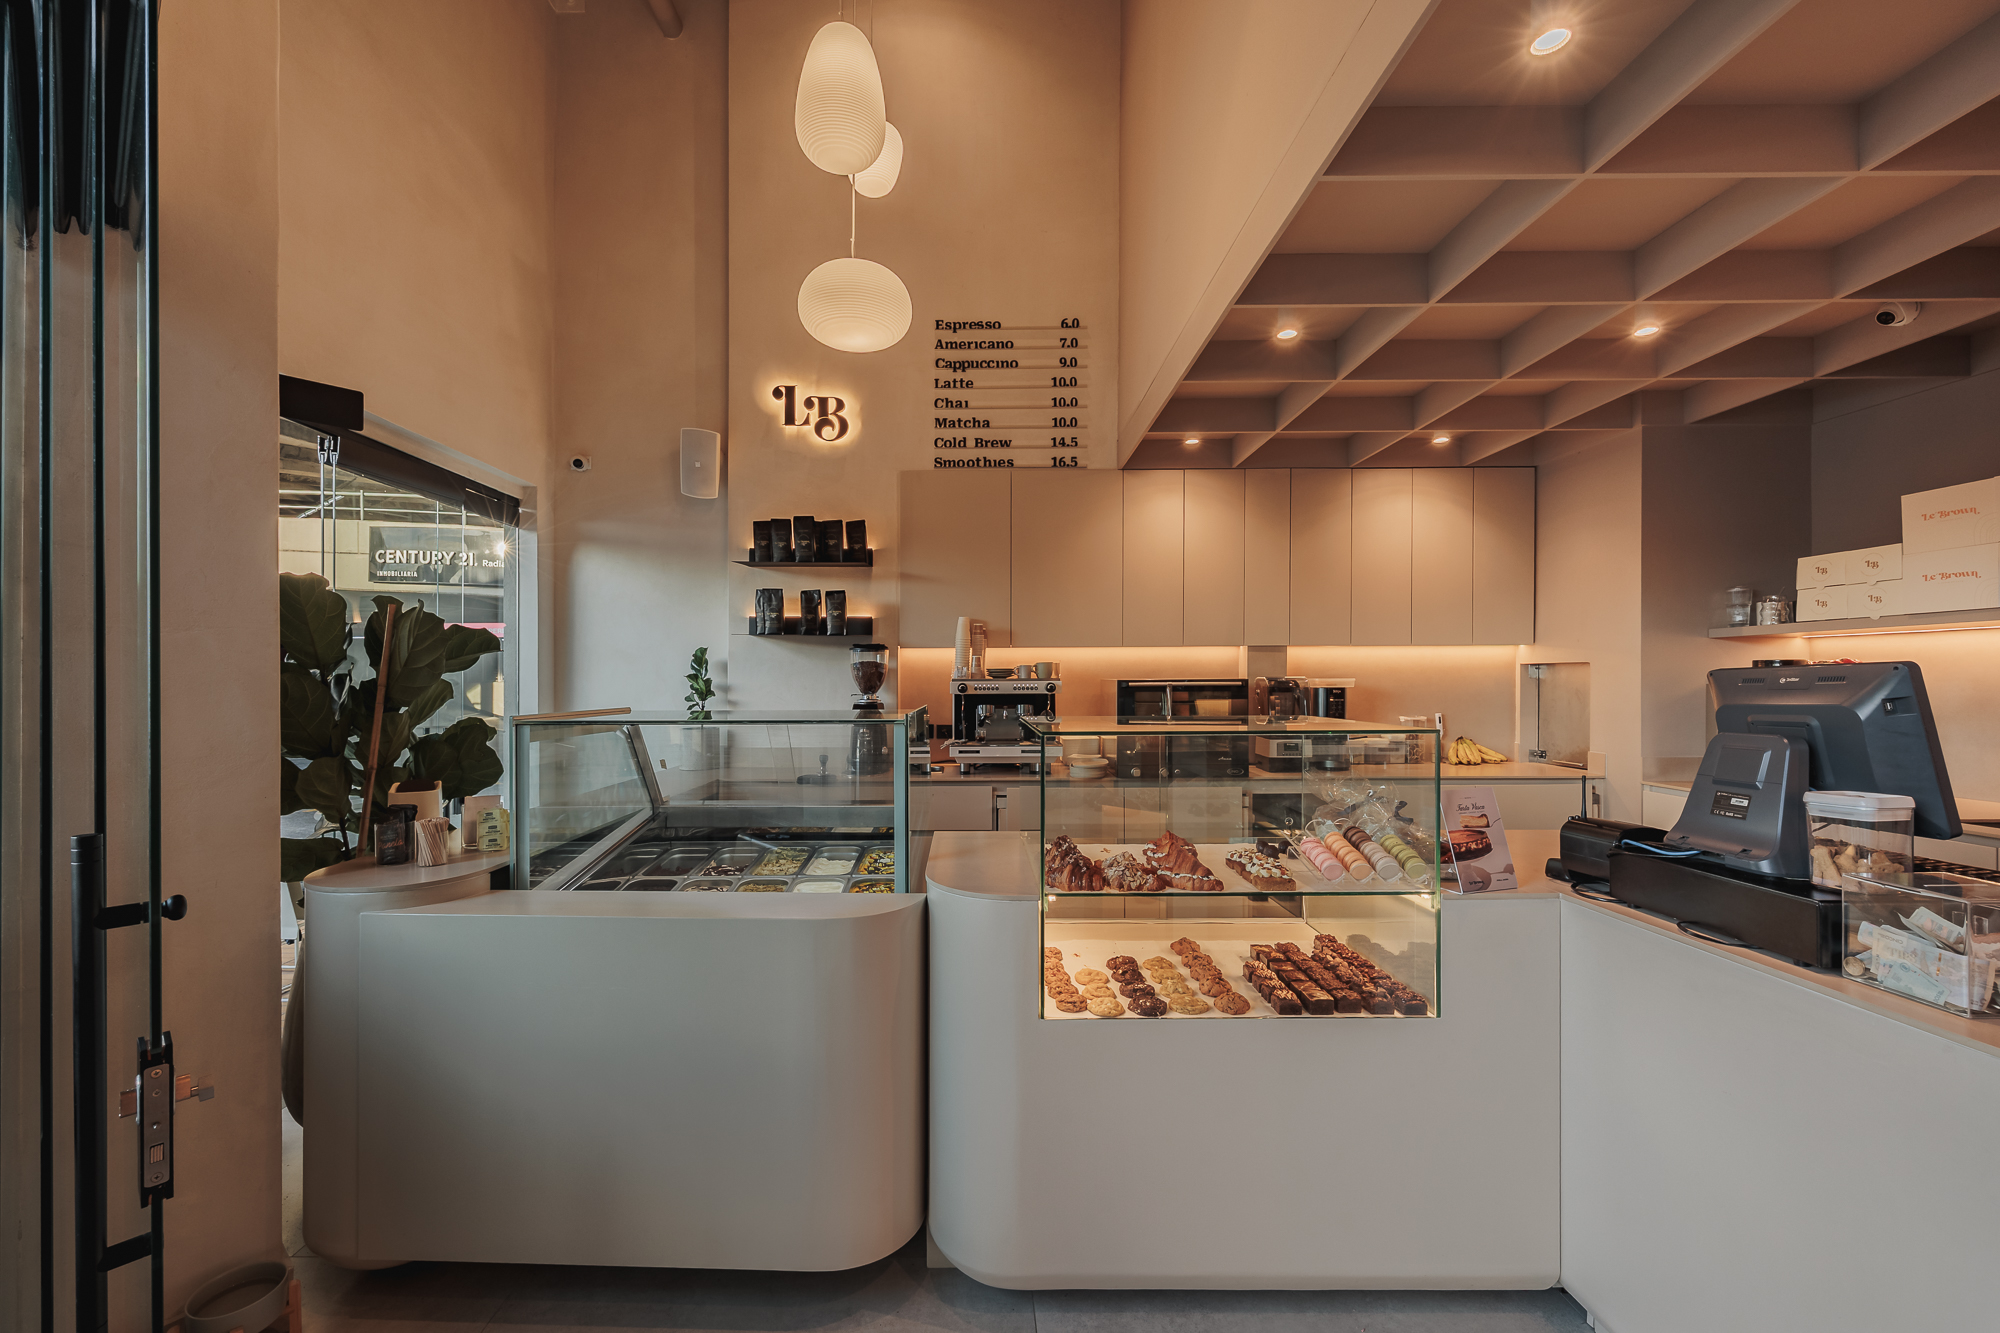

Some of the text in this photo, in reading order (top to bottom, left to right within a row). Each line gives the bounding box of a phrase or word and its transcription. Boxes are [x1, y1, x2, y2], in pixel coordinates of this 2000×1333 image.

[934, 318, 1080, 333] Espresso 6.0
[934, 337, 1078, 350] Americano 7.0
[935, 357, 1078, 372] Cappuccino 9.0
[934, 376, 1077, 389] Latte 10.0
[934, 397, 1078, 409] Chai 10.0
[772, 385, 849, 442] LB
[934, 417, 1078, 428] Matcha 10.0
[934, 437, 1078, 449] Cold Brew 14.5
[934, 456, 1078, 468] Smoothies 16.5
[375, 549, 455, 566] CENTURY
